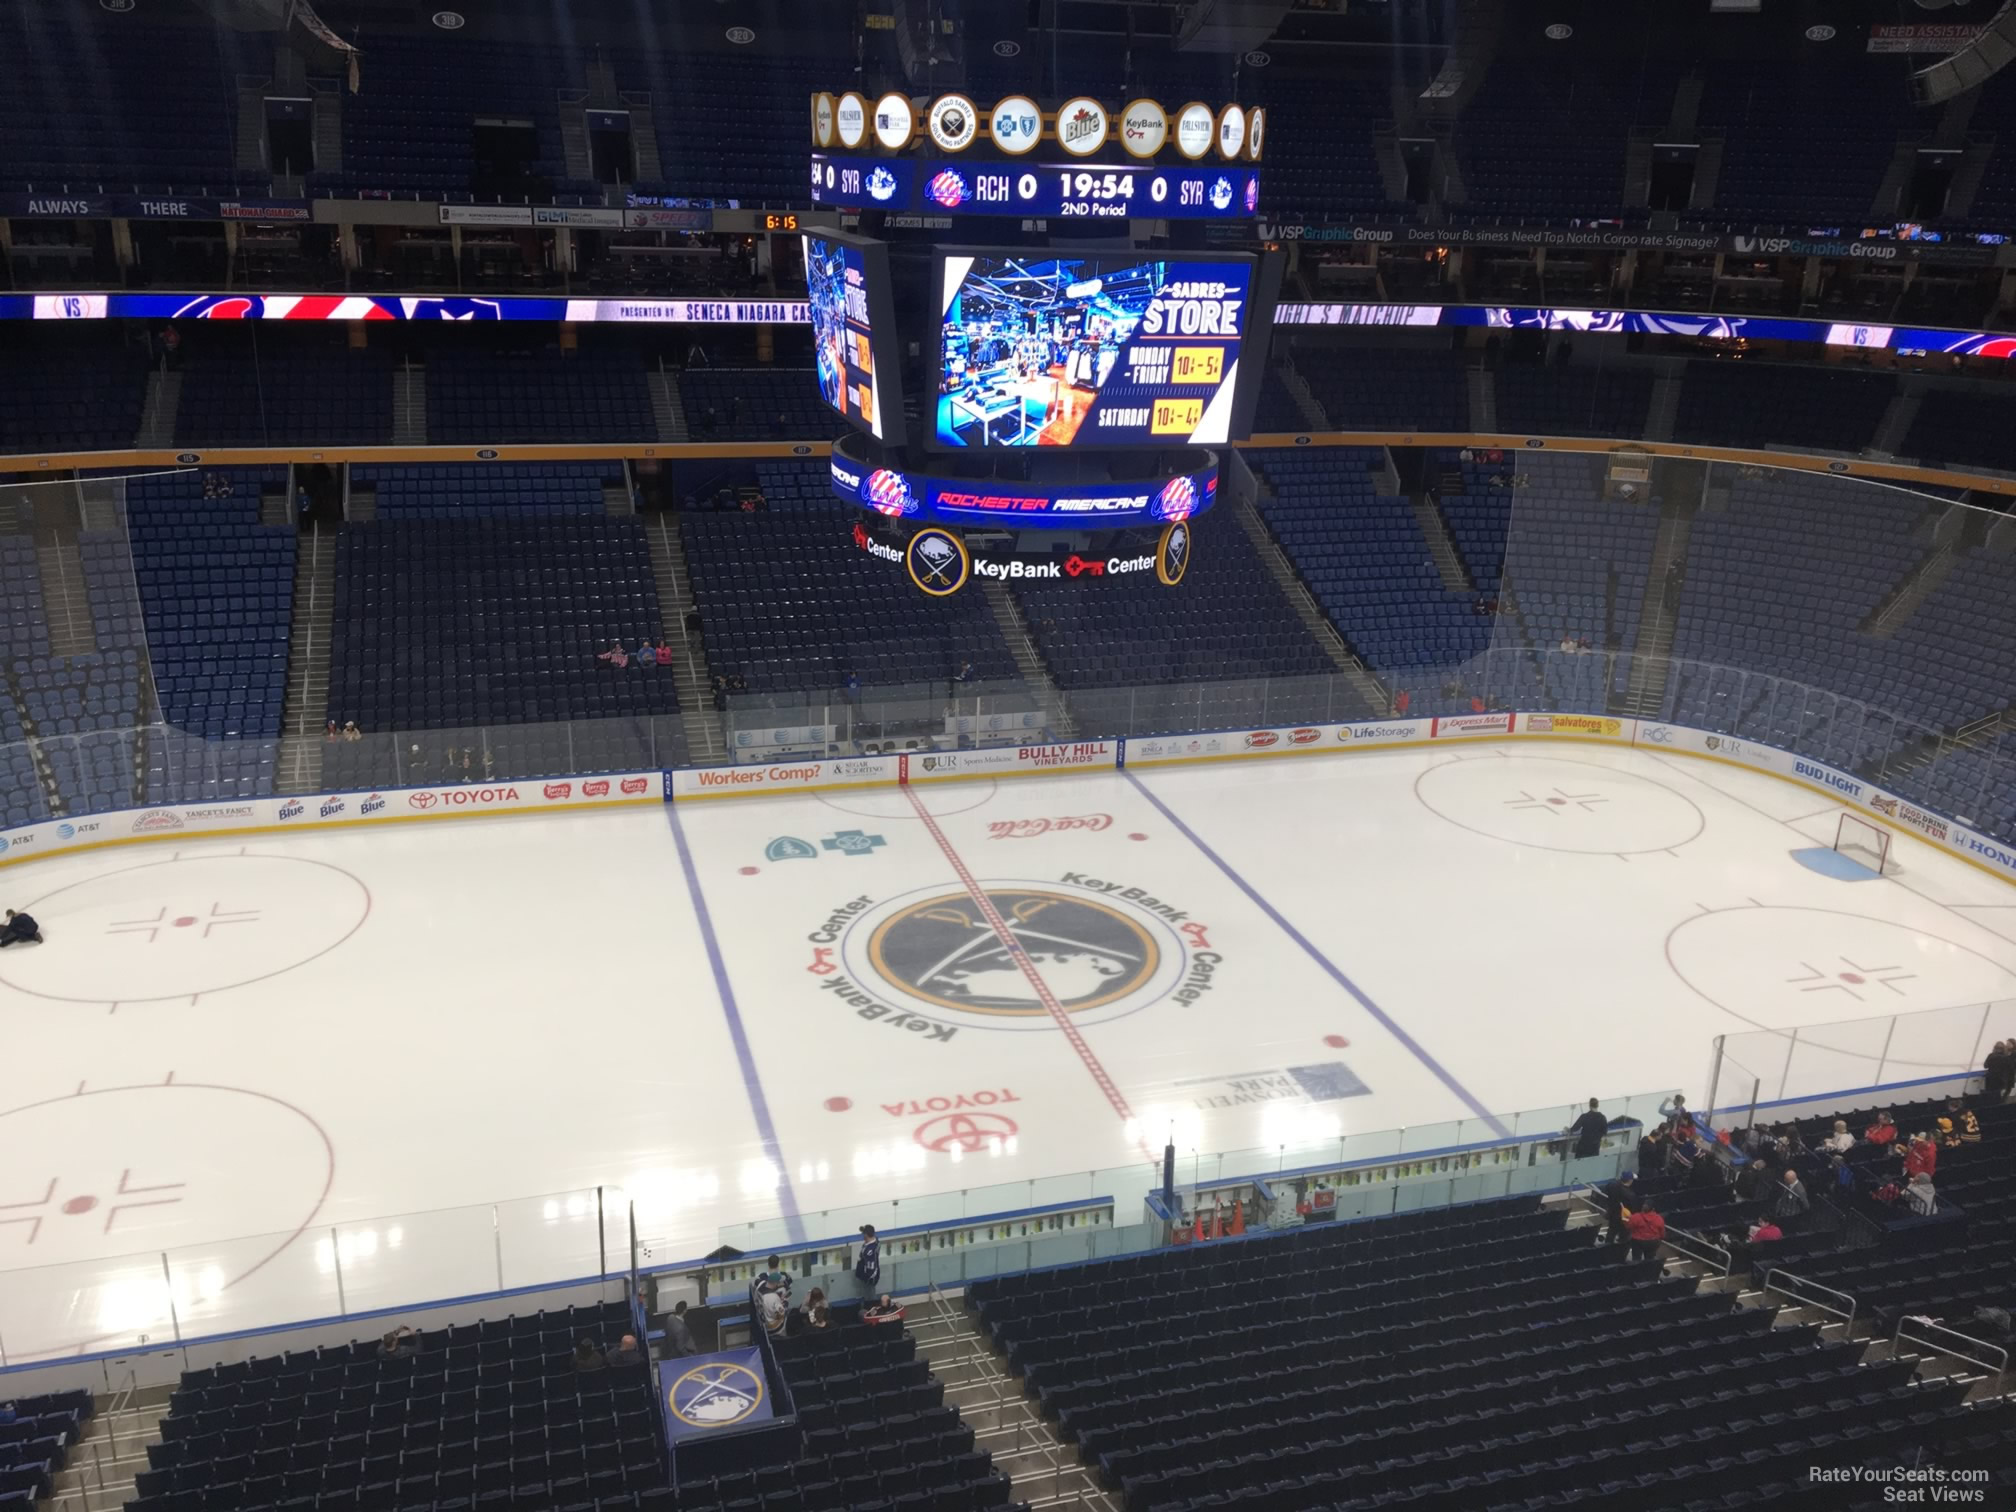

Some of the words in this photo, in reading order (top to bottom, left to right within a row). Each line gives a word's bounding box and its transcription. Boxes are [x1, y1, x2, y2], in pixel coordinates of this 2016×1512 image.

[441, 15, 456, 26] 319
[733, 30, 748, 40] 320
[1879, 26, 1914, 37] NEED
[933, 98, 954, 118] BUFFALO
[954, 99, 972, 119] SABRES
[1066, 117, 1100, 143] Blue
[1126, 119, 1163, 131] KeyBank
[931, 123, 942, 139] GOLD
[940, 137, 953, 147] RING
[953, 123, 974, 146] PARTNERS
[826, 165, 835, 189] 0
[841, 168, 860, 194] SYR
[976, 175, 1009, 201] RCH
[1018, 173, 1037, 199] 0
[1060, 172, 1134, 199] 19:54
[1151, 177, 1168, 202] 0
[1180, 180, 1204, 205] SYR
[28, 200, 89, 214] ALWAYS
[140, 201, 188, 216] THERE
[221, 208, 264, 217] NATIONAL
[264, 207, 296, 218] GUARD
[1061, 202, 1089, 216] 2ND
[1092, 203, 1126, 217] Period
[766, 216, 797, 229] 6:15
[1408, 229, 1435, 240] Does
[1437, 229, 1461, 240] Your
[1512, 231, 1542, 243] Need
[1544, 232, 1565, 245] Top
[1567, 232, 1601, 244] Notch
[1665, 234, 1720, 250] Signage?
[1171, 282, 1226, 298] SABRES
[63, 297, 81, 317] VS
[621, 307, 662, 317] PRESENTED
[664, 308, 675, 318] BY
[687, 304, 731, 321] SENECA
[737, 304, 786, 321] NIAGARA
[1142, 299, 1242, 334] STORE
[1854, 327, 1868, 344] VS
[1128, 347, 1172, 366] MONDAY
[1098, 408, 1150, 426] SATURDAY
[936, 493, 1048, 510] ROCHESTER
[1053, 495, 1150, 511] AMERICANS
[866, 539, 904, 563] Center
[974, 558, 1061, 580] KeyBank
[1107, 554, 1157, 575] Center
[1450, 718, 1484, 728] Express
[1485, 716, 1508, 726] Mart
[1554, 715, 1602, 729] salvatores
[1018, 746, 1069, 760] BULLY
[1074, 743, 1108, 756] HILL
[1720, 740, 1741, 753] UR
[937, 755, 957, 768] UR
[1034, 755, 1093, 767] VINEYARDS
[699, 769, 767, 786] Workers'
[769, 764, 821, 783] Comp?
[1795, 761, 1824, 782] BUD
[1825, 772, 1862, 797] LIGHT
[441, 788, 519, 805] TOYOTA
[185, 810, 224, 818] YANCEY'S
[225, 807, 252, 815] FANCY
[279, 805, 304, 821] Blue
[320, 803, 344, 818] Blue
[360, 799, 385, 815] Blue
[988, 813, 1113, 840] Coca-Cola
[1899, 812, 1926, 829] SPORTS
[1925, 826, 1948, 841] FUN
[1900, 805, 1922, 820] FOOD
[1922, 816, 1949, 832] DRINK
[78, 822, 101, 834] AT&T
[11, 834, 34, 847] AT&T
[807, 895, 874, 944] Center
[1060, 872, 1188, 923] KeyBank
[1172, 952, 1223, 1008] Center
[820, 975, 959, 1042] KeyBank
[1225, 1075, 1289, 1092] PARK
[880, 1088, 1022, 1117] TOYOTA
